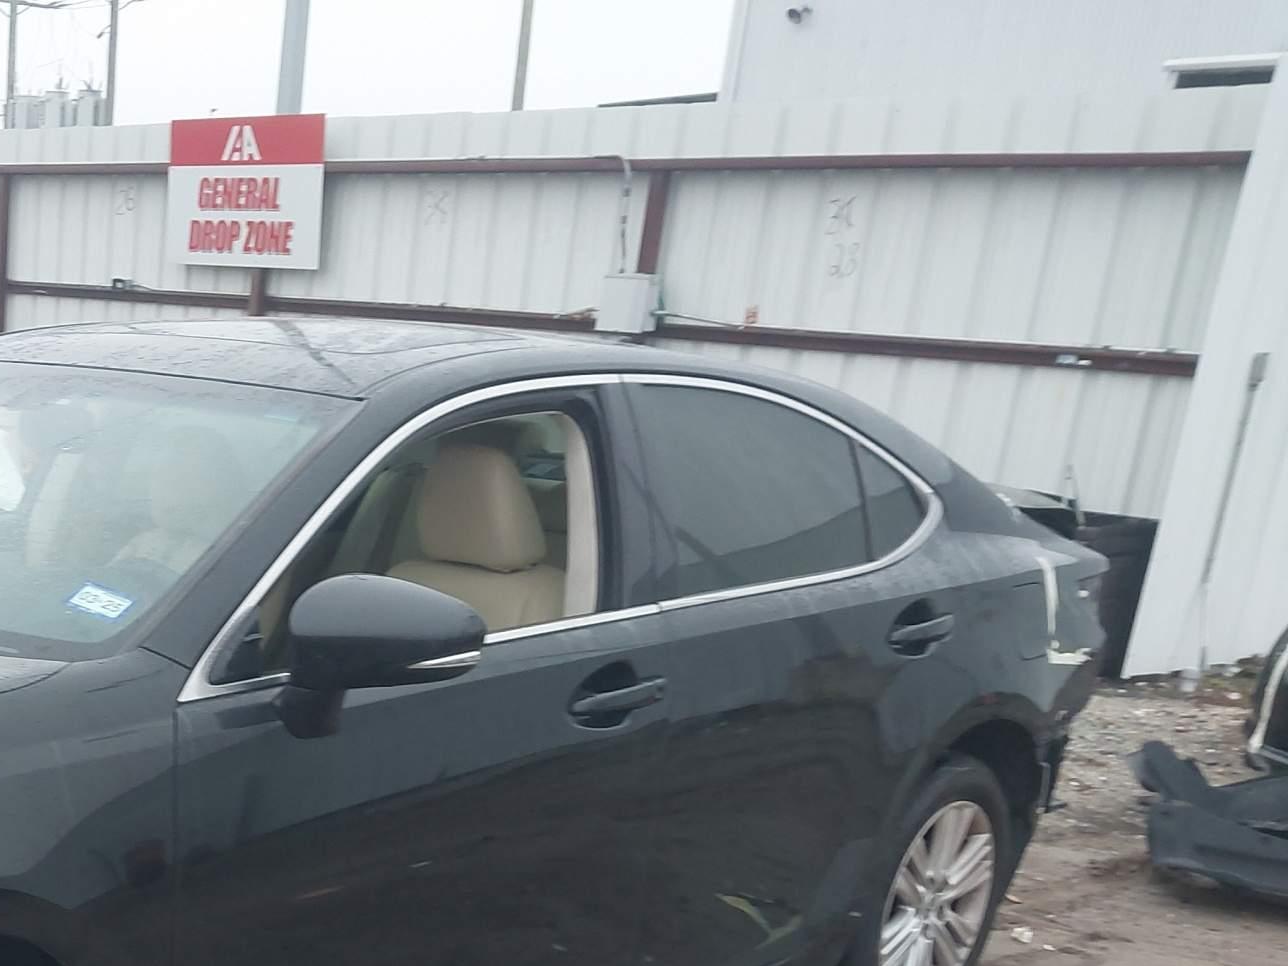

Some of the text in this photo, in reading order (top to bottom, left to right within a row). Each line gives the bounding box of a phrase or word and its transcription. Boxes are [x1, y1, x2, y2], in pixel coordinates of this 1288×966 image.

[198, 177, 280, 211] GENERAL
[188, 219, 295, 255] DROP ZONE
